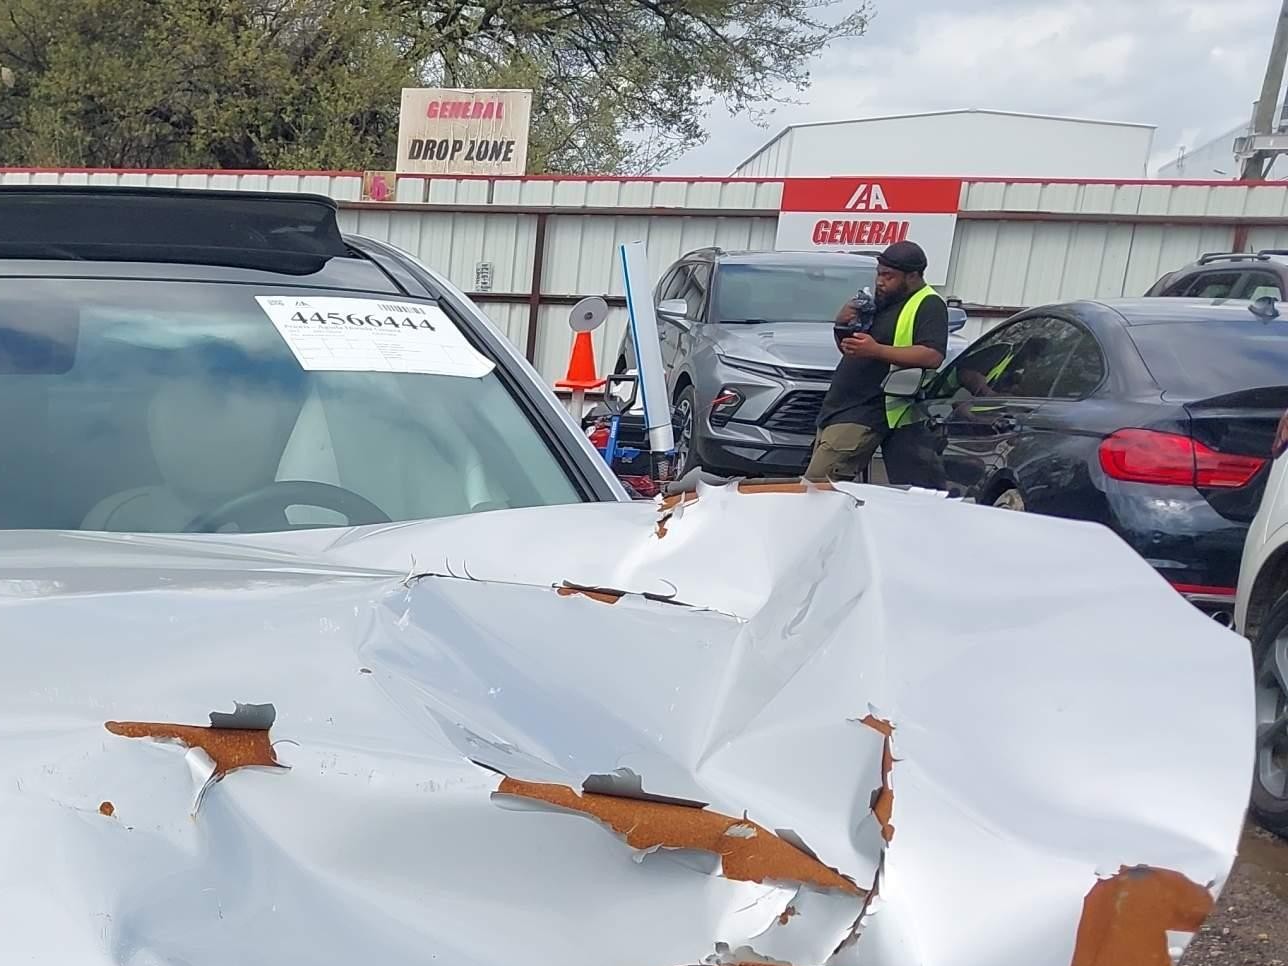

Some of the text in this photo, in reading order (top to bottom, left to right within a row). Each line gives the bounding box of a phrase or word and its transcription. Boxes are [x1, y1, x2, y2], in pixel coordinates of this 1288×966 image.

[426, 101, 504, 119] GENERAL
[408, 138, 515, 162] DROP ZONE
[812, 220, 910, 245] GENERAL
[290, 311, 436, 332] 44566444
